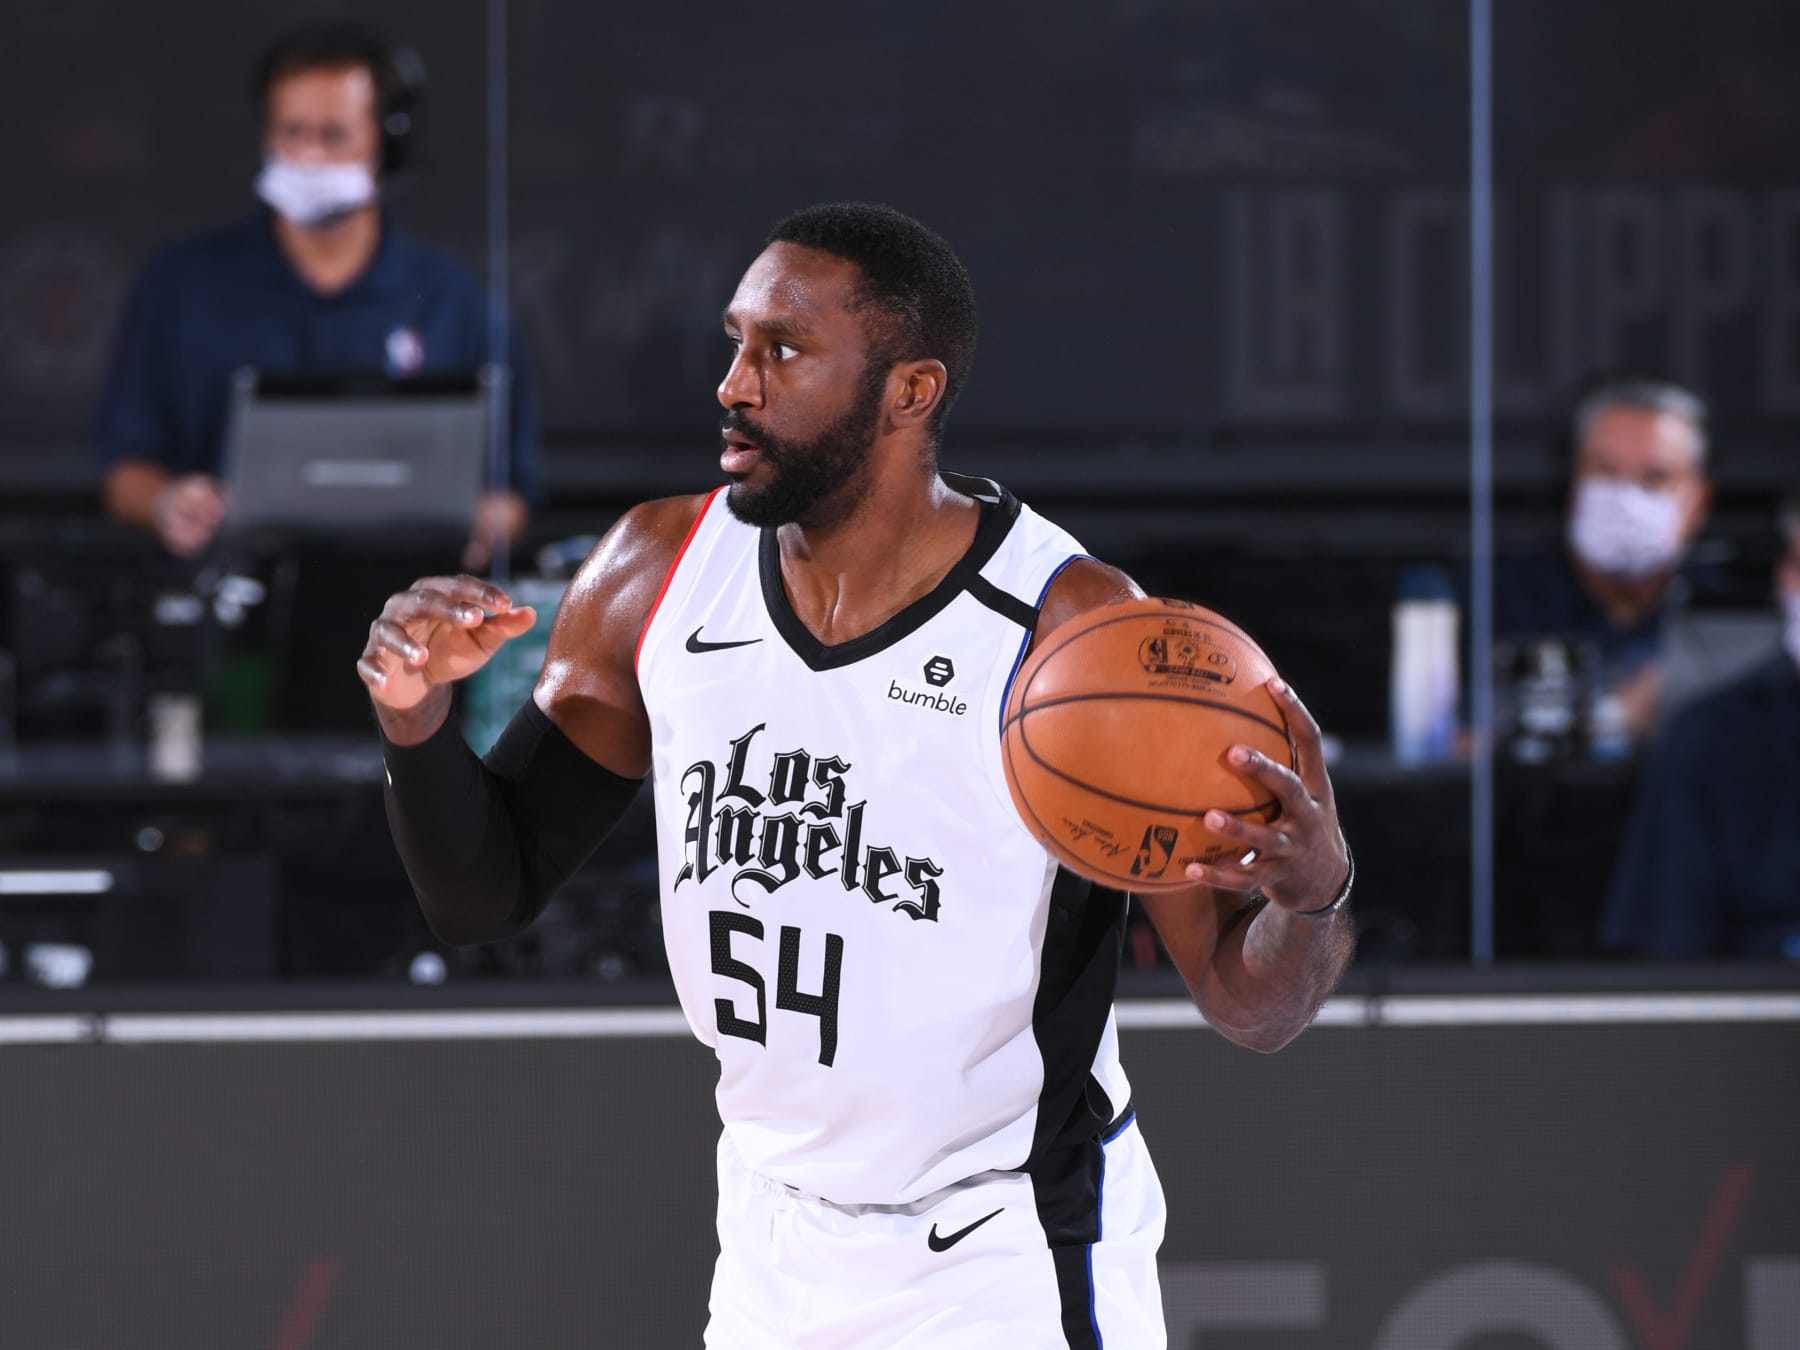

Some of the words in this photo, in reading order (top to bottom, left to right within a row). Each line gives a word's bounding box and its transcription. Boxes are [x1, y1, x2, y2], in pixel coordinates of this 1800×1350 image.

[887, 679, 967, 716] bumble
[715, 722, 852, 820] Los
[674, 760, 945, 923] Angeles
[709, 910, 844, 1068] 54
